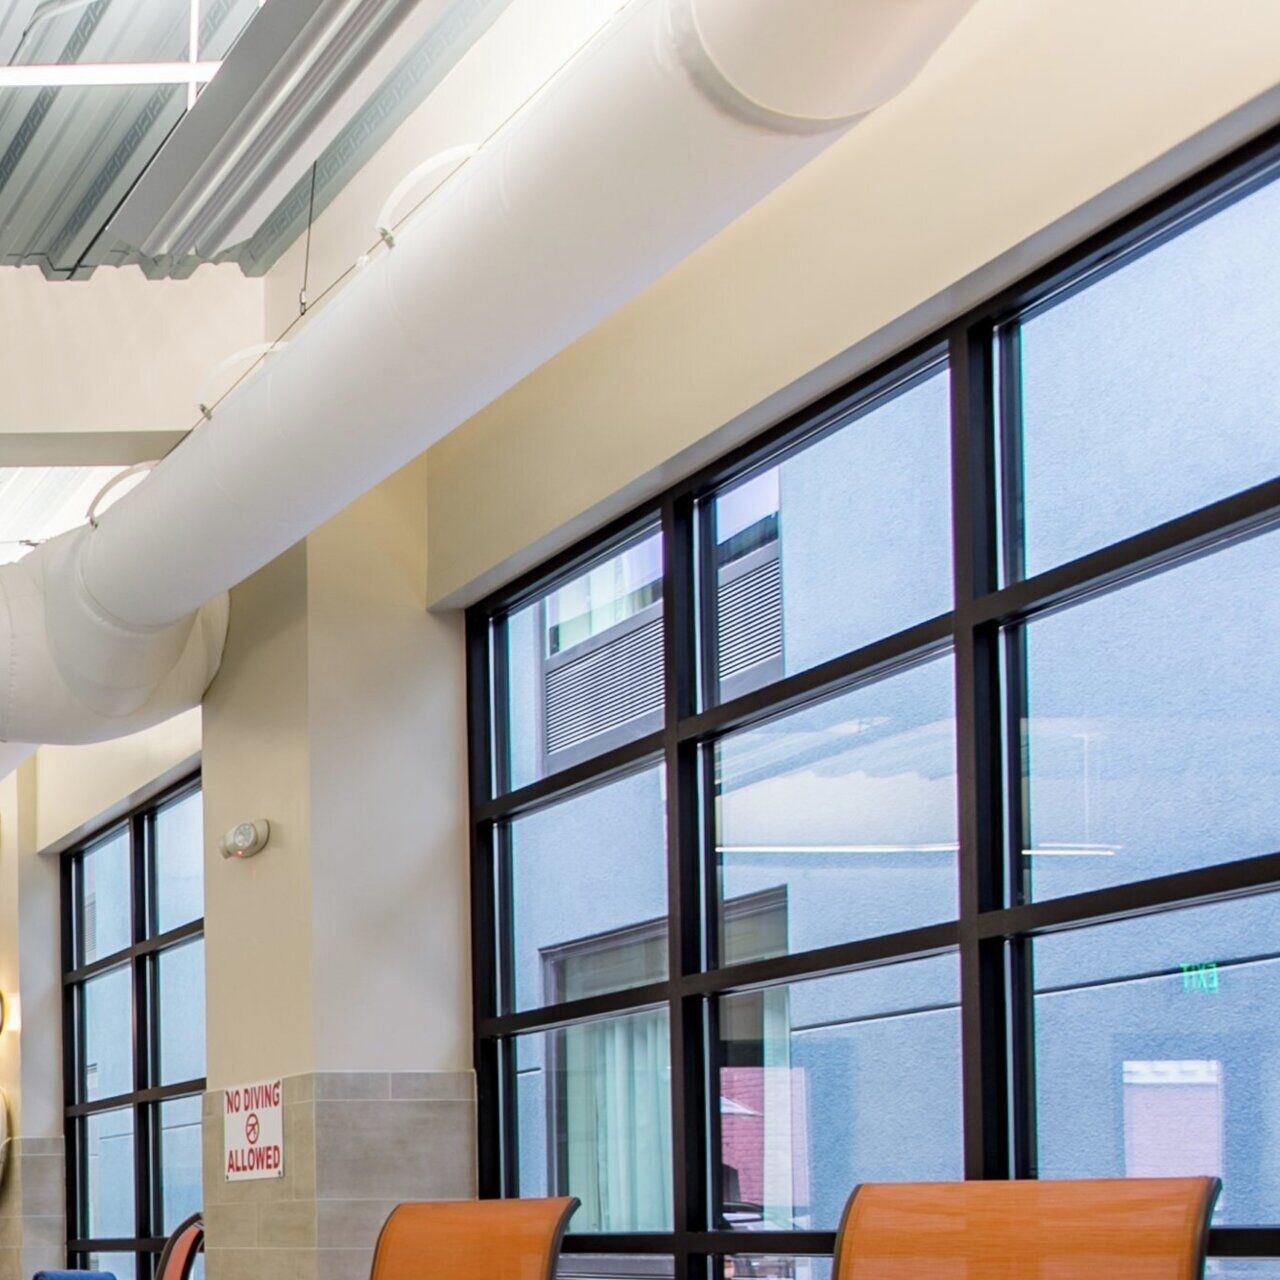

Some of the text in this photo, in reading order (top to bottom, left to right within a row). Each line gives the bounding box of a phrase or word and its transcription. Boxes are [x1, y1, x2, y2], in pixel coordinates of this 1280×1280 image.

[226, 1083, 280, 1114] NO DIVING
[227, 1145, 280, 1173] ALLOWED
